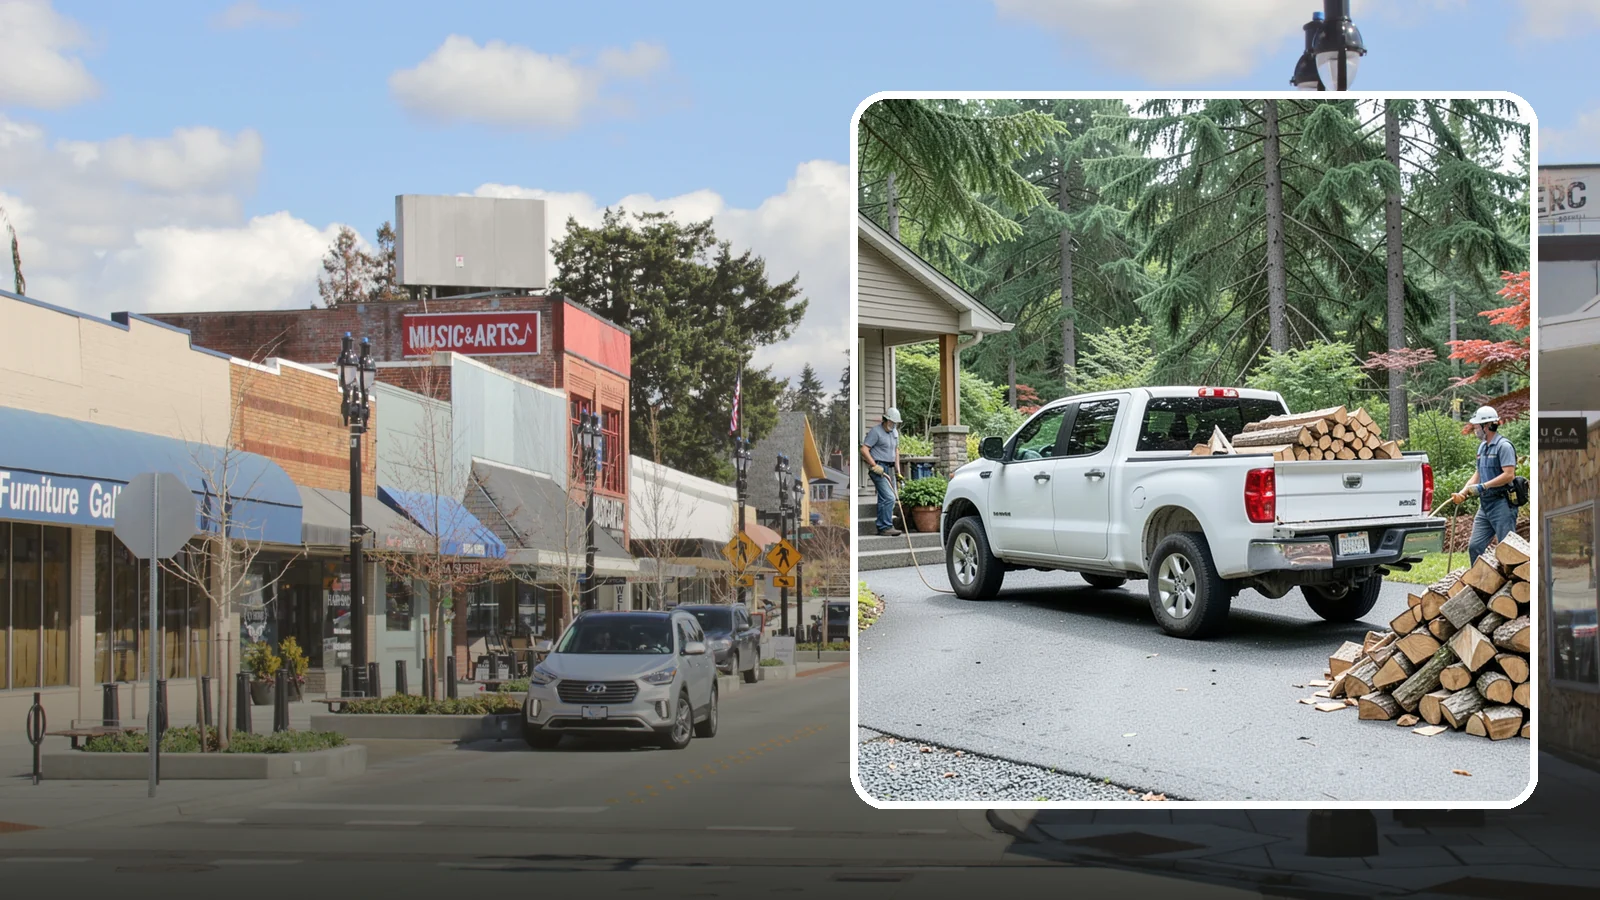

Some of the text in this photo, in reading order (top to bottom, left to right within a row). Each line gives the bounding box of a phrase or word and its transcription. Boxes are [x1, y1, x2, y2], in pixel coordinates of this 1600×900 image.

[409, 322, 520, 349] MUSIC&ARTS
[0, 471, 121, 519] Furniture Gal
